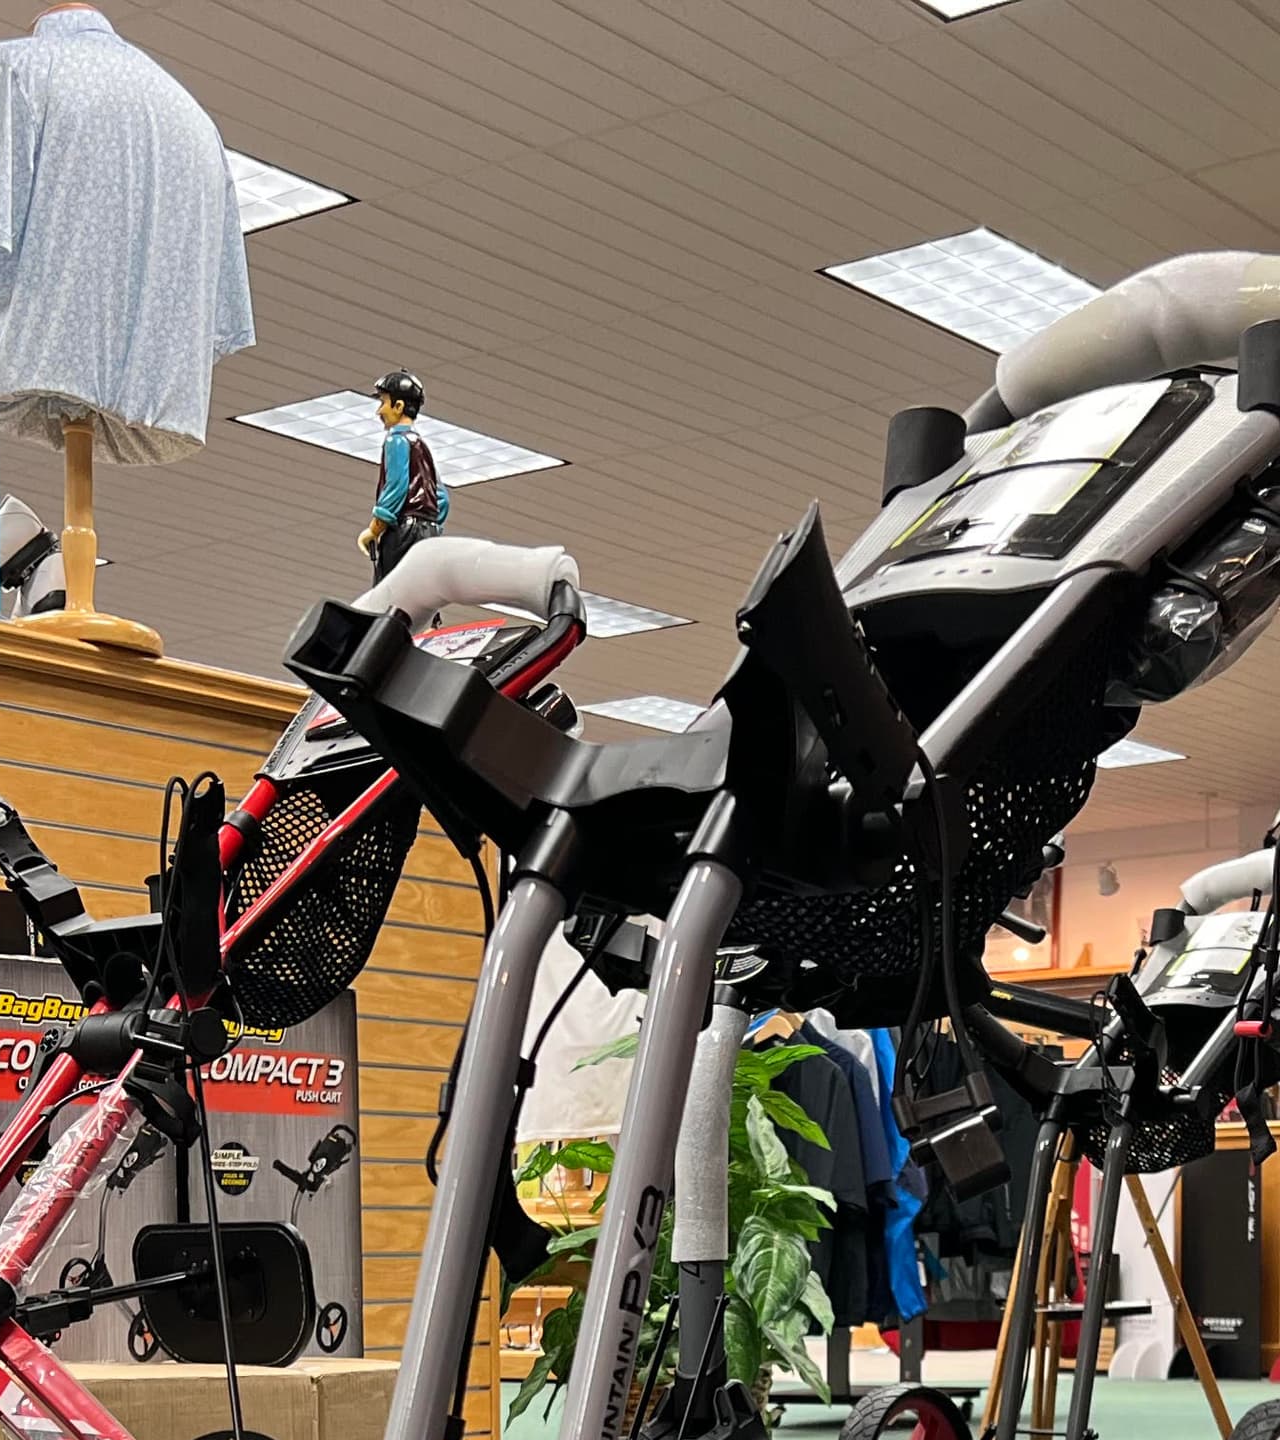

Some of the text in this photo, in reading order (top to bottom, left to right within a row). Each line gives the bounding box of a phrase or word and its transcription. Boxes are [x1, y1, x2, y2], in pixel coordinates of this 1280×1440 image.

[200, 1053, 345, 1087] OMPACT 3
[295, 1090, 343, 1104] PUSH CART
[213, 1152, 242, 1160] SIMPLE
